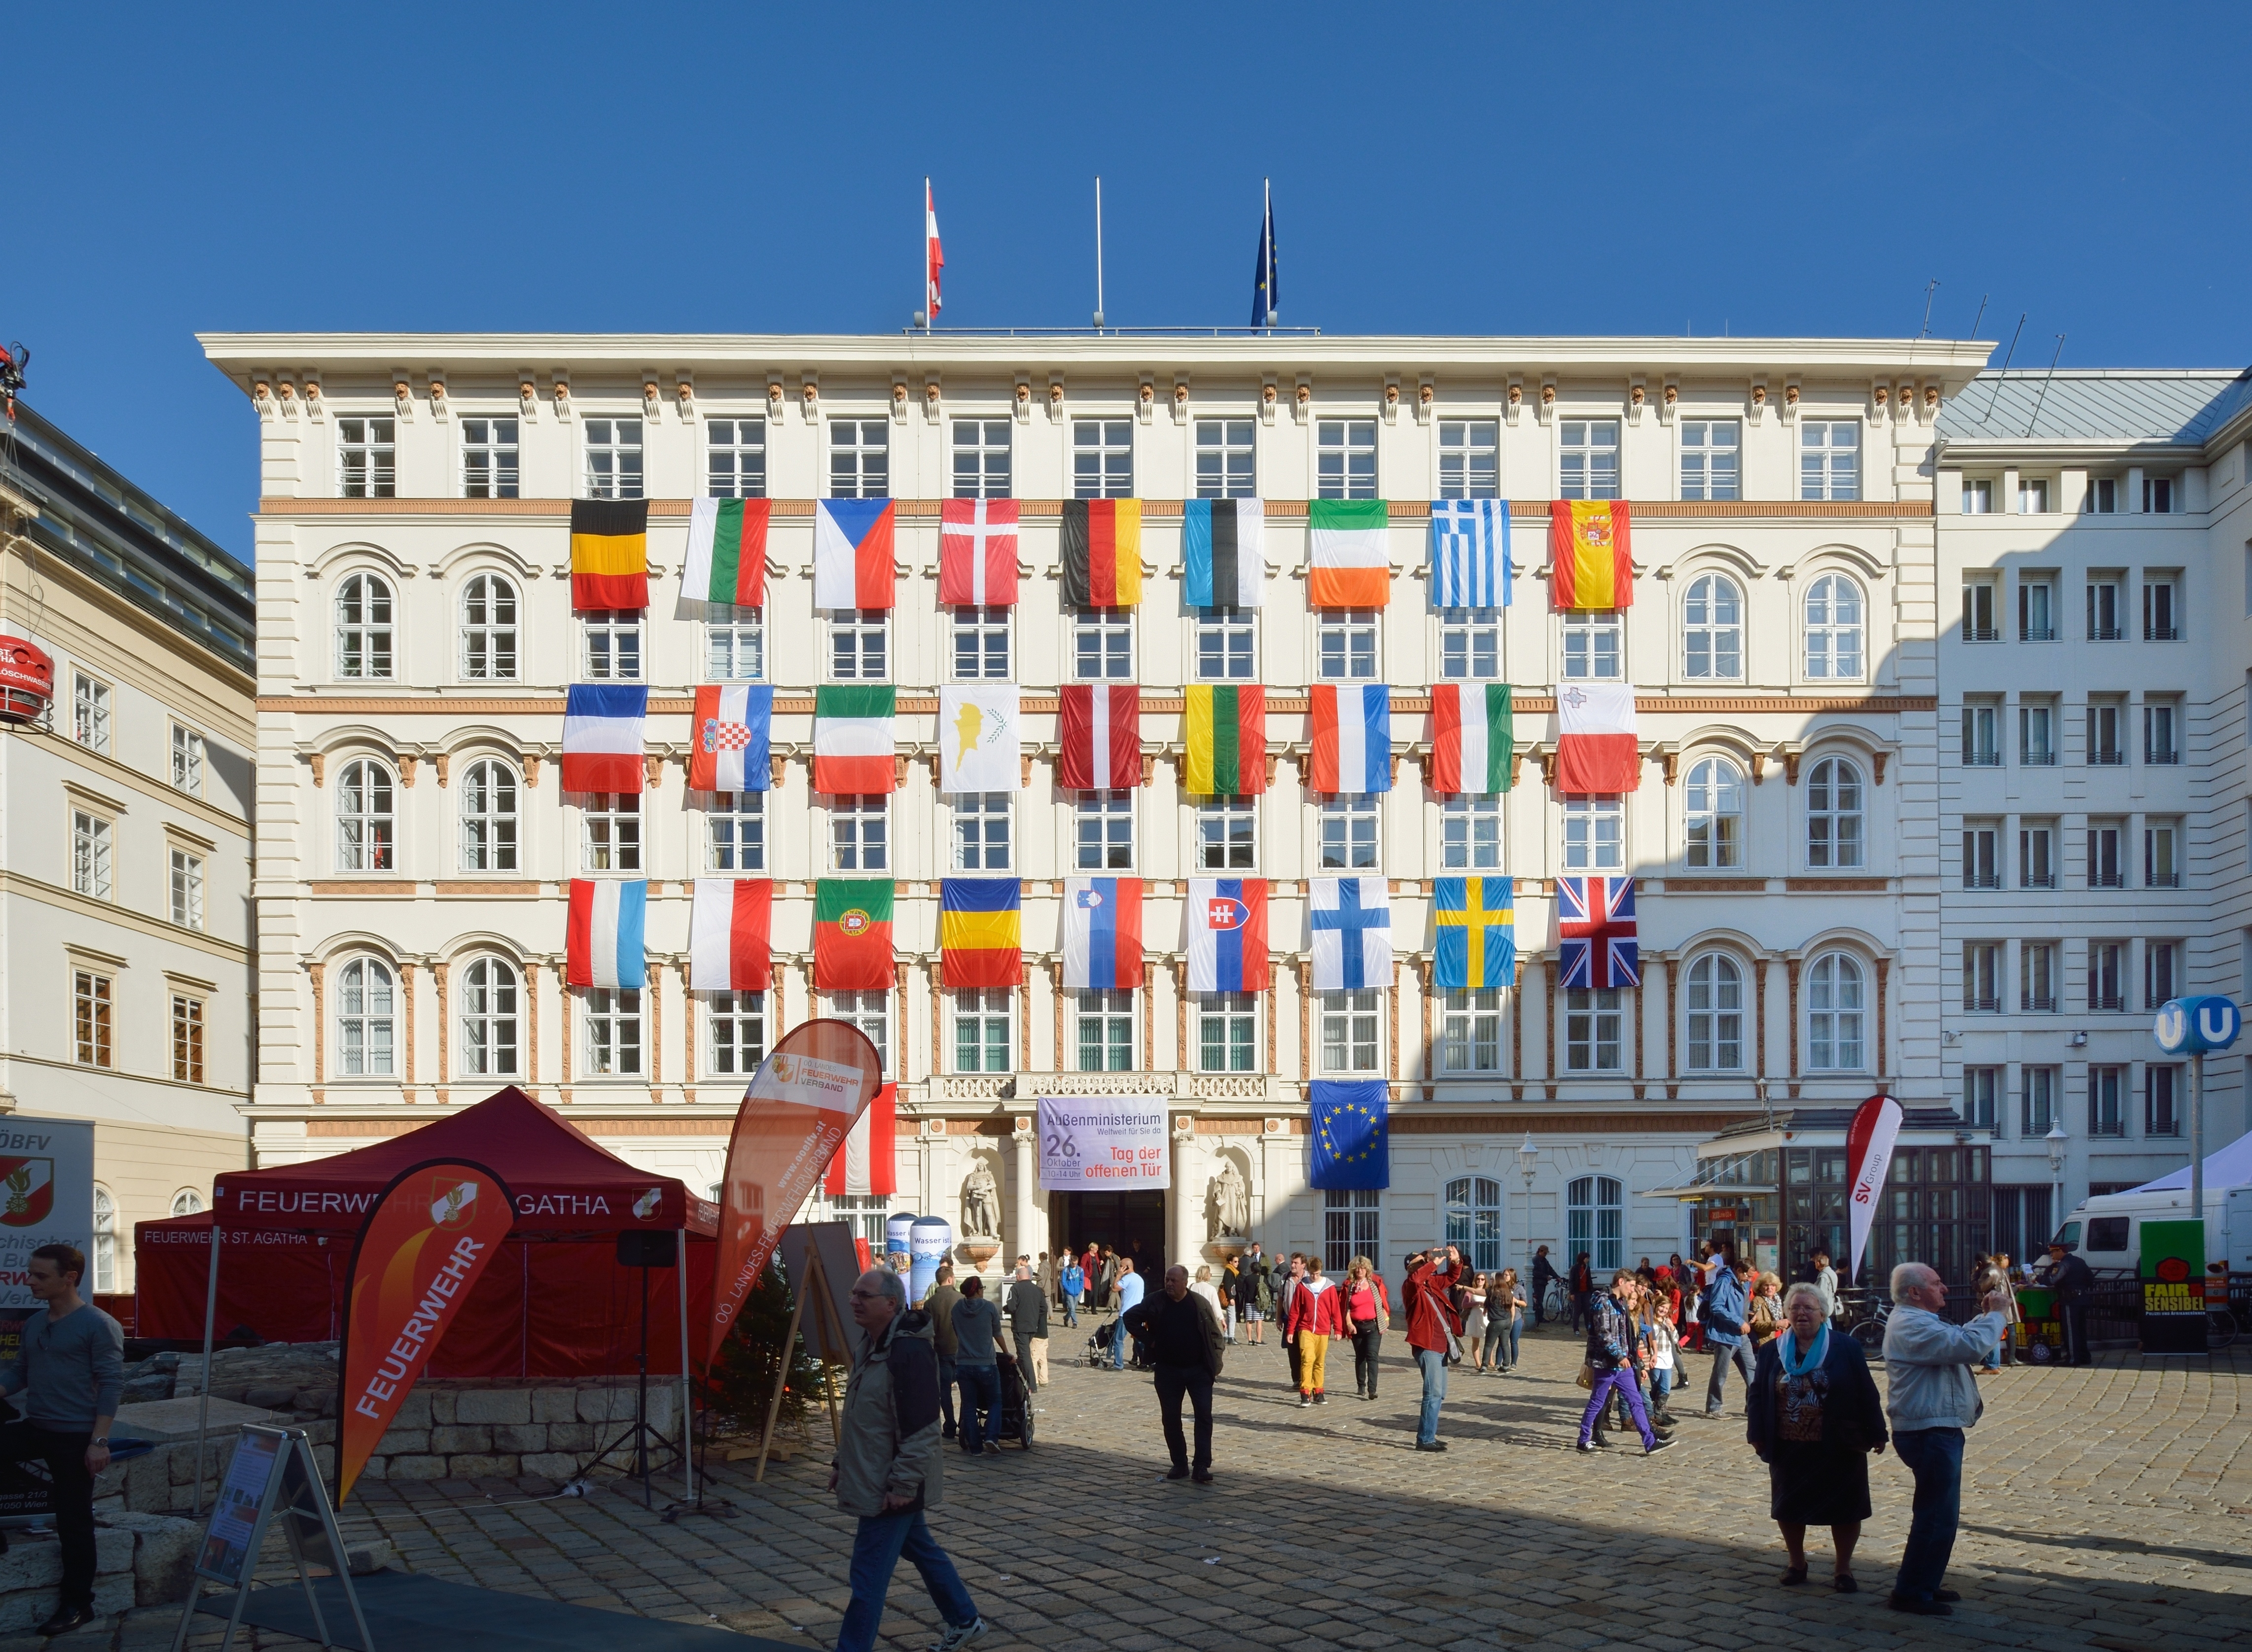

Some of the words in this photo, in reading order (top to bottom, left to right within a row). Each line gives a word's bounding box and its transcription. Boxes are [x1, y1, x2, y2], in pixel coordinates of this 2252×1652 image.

[0, 667, 51, 691] ÖSCHWASSER
[2158, 1010, 2181, 1047] U
[2200, 1007, 2232, 1042] U
[815, 1063, 837, 1072] LANDES
[801, 1068, 859, 1086] FEUERWEHR
[801, 1077, 843, 1092] VERBAND
[1047, 1113, 1161, 1126] Außenministerium
[778, 1120, 826, 1189] www.ooelfv.at
[1047, 1134, 1080, 1157] 26.
[1110, 1147, 1133, 1163] Tag
[1139, 1146, 1161, 1159] der
[1047, 1158, 1080, 1167] Oktober
[1085, 1164, 1137, 1178] offenen
[1141, 1163, 1161, 1177] Tür
[1856, 1182, 1871, 1204] SV
[1865, 1154, 1882, 1185] Group
[730, 1127, 842, 1298] LANDES-FEUERWEHRVERBAND
[231, 1233, 250, 1244] ST.
[253, 1233, 308, 1244] AGATHA
[2145, 1297, 2205, 1311] SENSIBEL
[355, 1236, 485, 1419] FEUERWEHR
